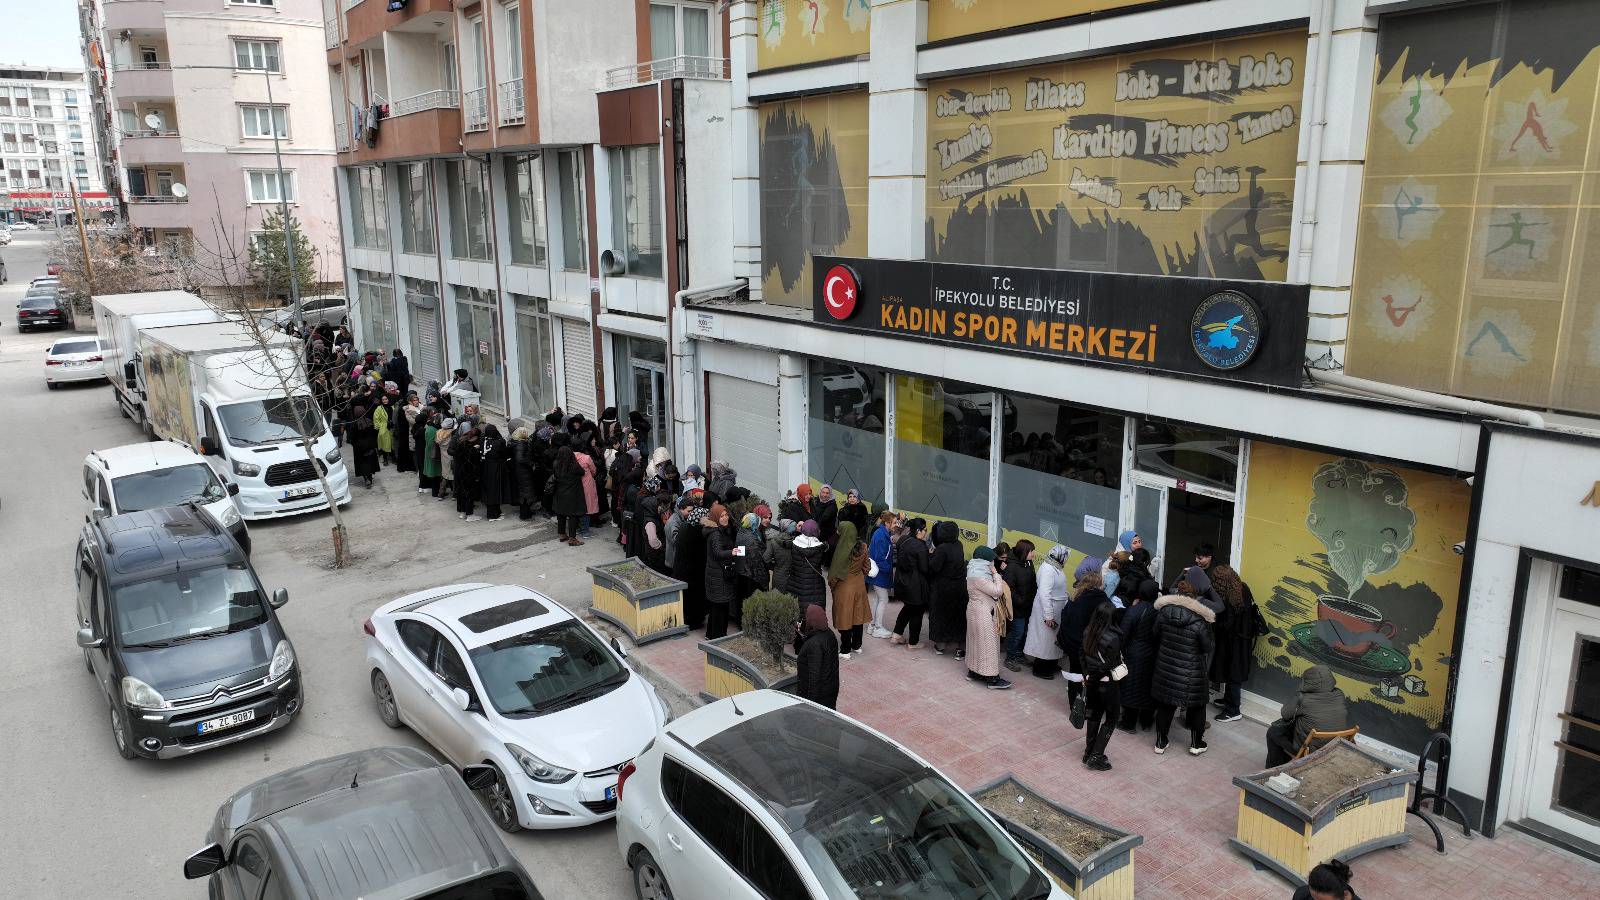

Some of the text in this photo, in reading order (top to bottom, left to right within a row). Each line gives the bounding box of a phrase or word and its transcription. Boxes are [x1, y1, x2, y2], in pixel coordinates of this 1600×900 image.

[1025, 79, 1085, 111] Pilates
[1115, 69, 1160, 102] Boks
[1182, 58, 1232, 96] Kick
[1238, 52, 1293, 89] Boks
[1052, 119, 1229, 160] Kardiyo Fitness
[1237, 105, 1294, 144] Tango
[937, 123, 993, 170] Zumba
[935, 286, 1080, 316] İPEKYOLU BELEDİYESİ
[992, 276, 1015, 291] T.C.
[881, 303, 1157, 362] KADIN SPOR MERKEZİ
[203, 722, 213, 731] 34
